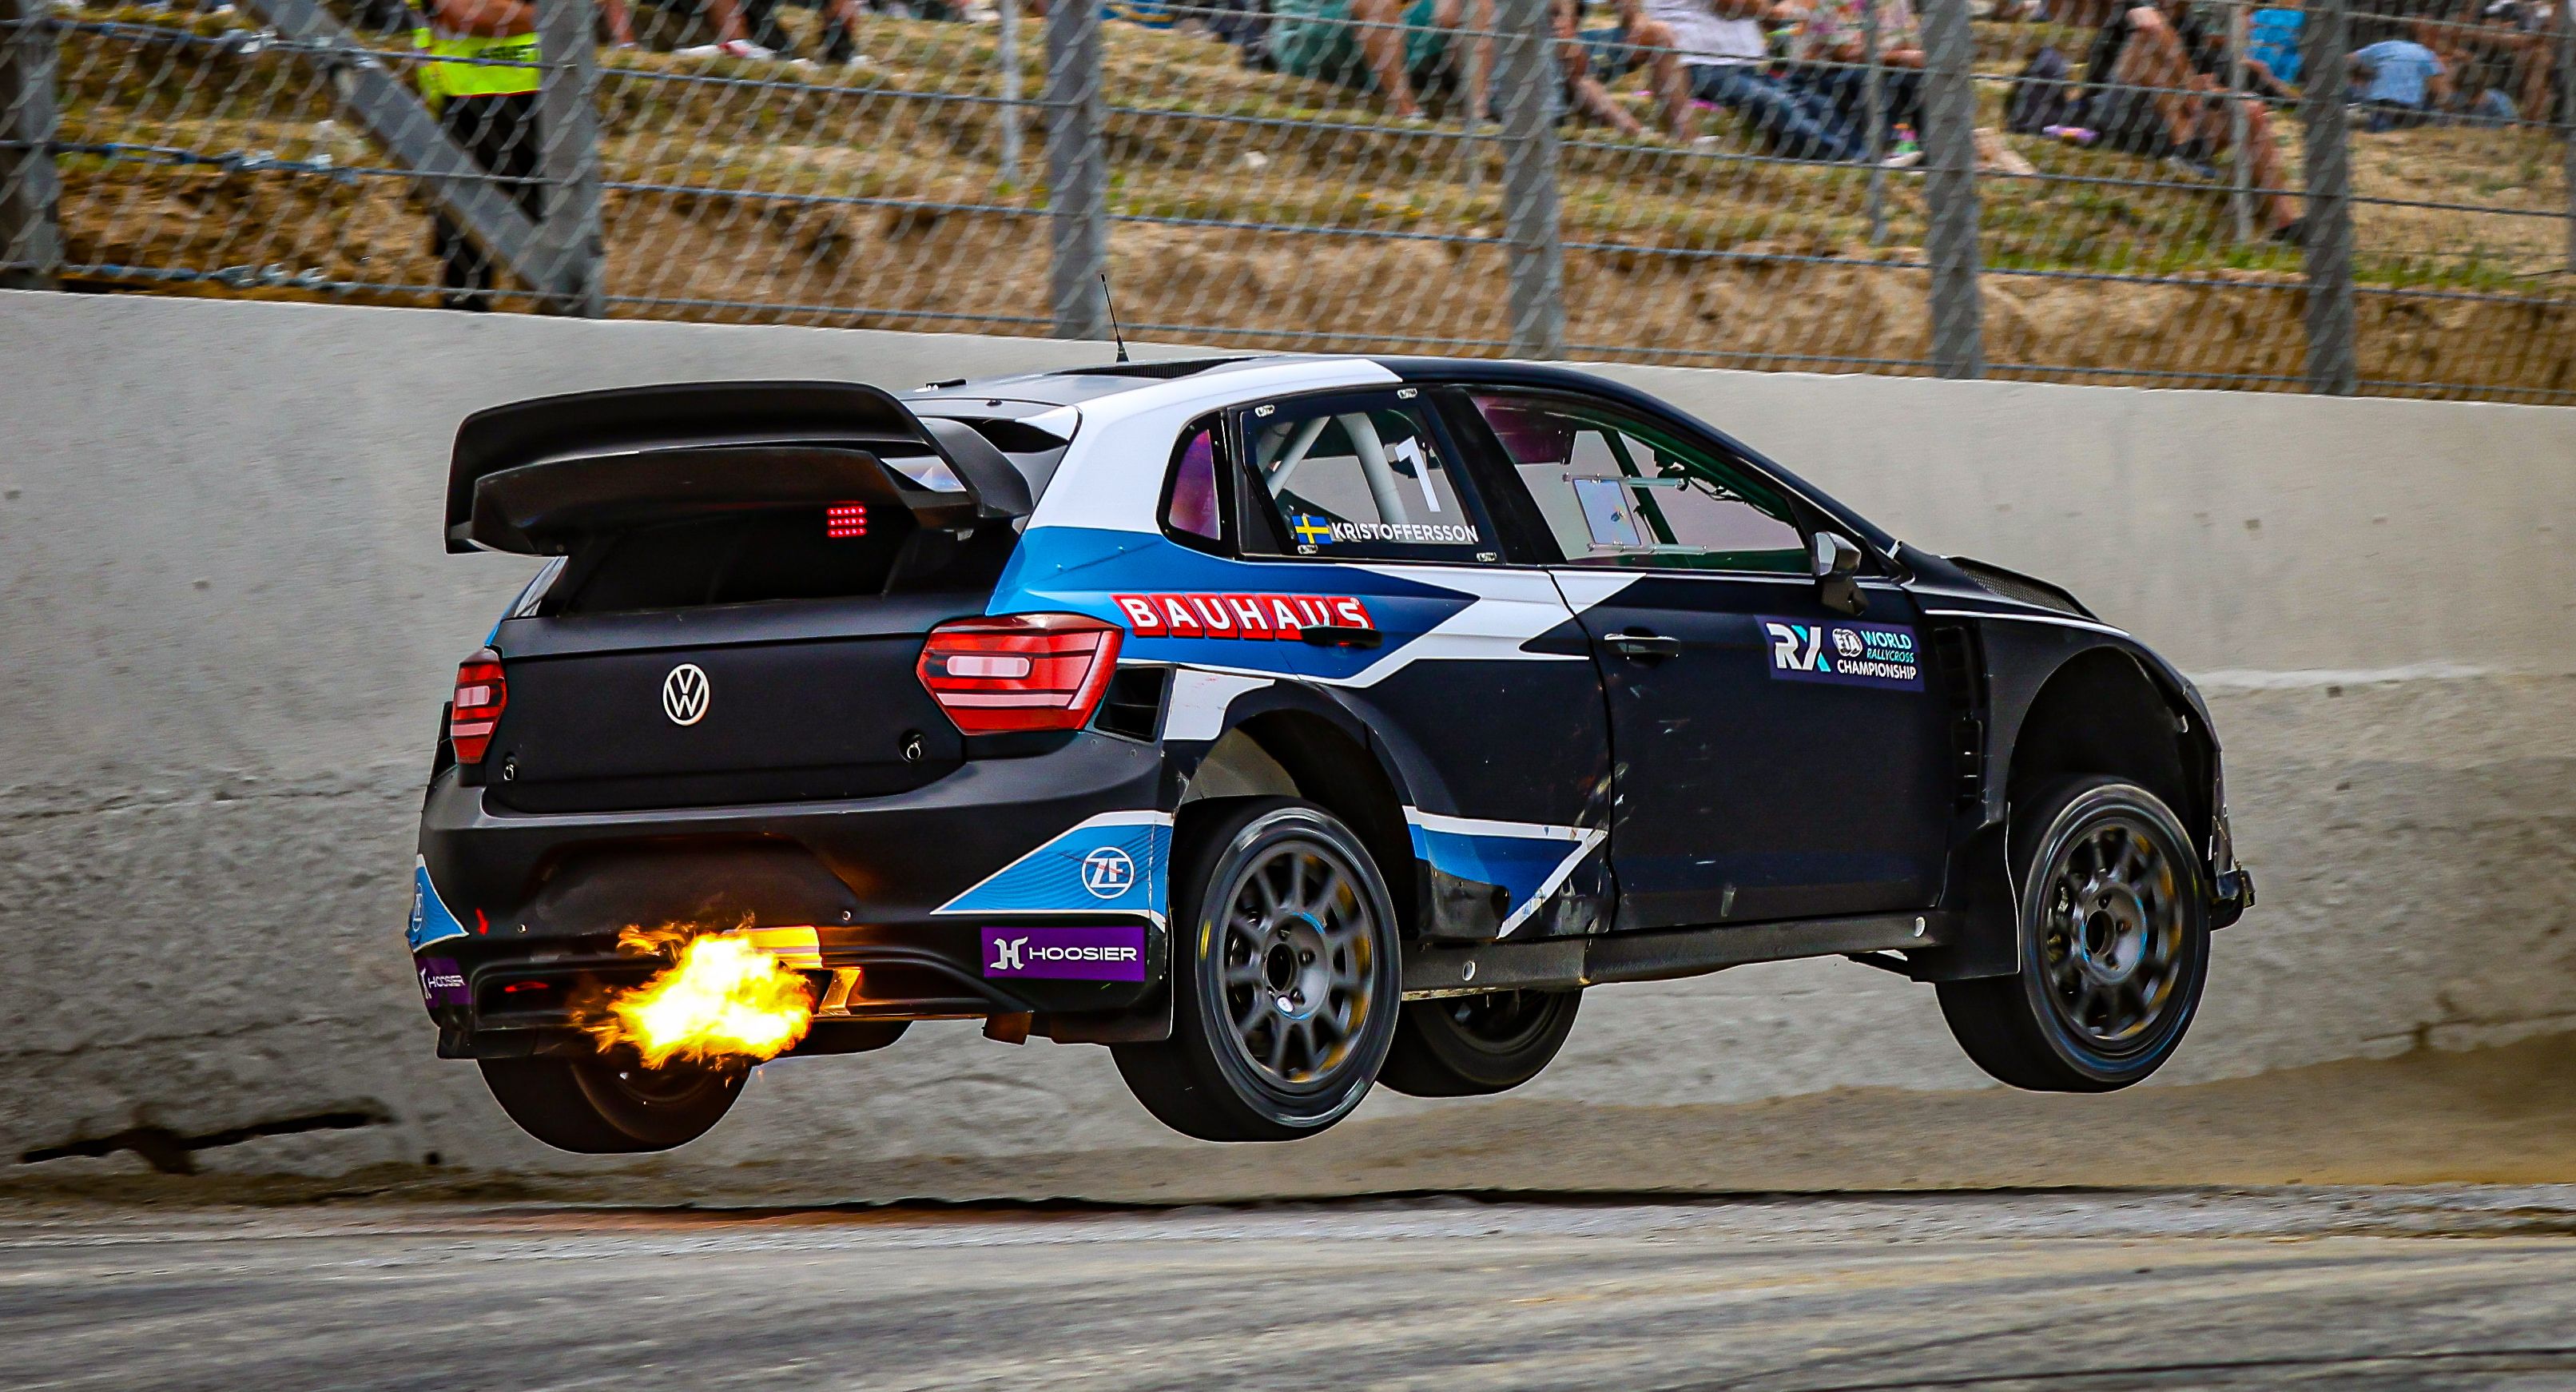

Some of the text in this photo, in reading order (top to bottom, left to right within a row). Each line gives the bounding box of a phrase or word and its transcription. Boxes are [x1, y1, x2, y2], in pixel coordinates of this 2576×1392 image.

[1394, 435, 1441, 512] 1
[1332, 522, 1479, 543] KRISTOFFERSSON
[1120, 598, 1369, 630] BAUHAUS
[1766, 622, 1831, 672] RX
[1861, 630, 1912, 650] WORLD
[1866, 648, 1914, 663] RALLYCROSS
[1837, 659, 1917, 680] CHAMPIONSHIP
[1084, 853, 1132, 893] ZF
[1028, 947, 1138, 961] HOOSIER
